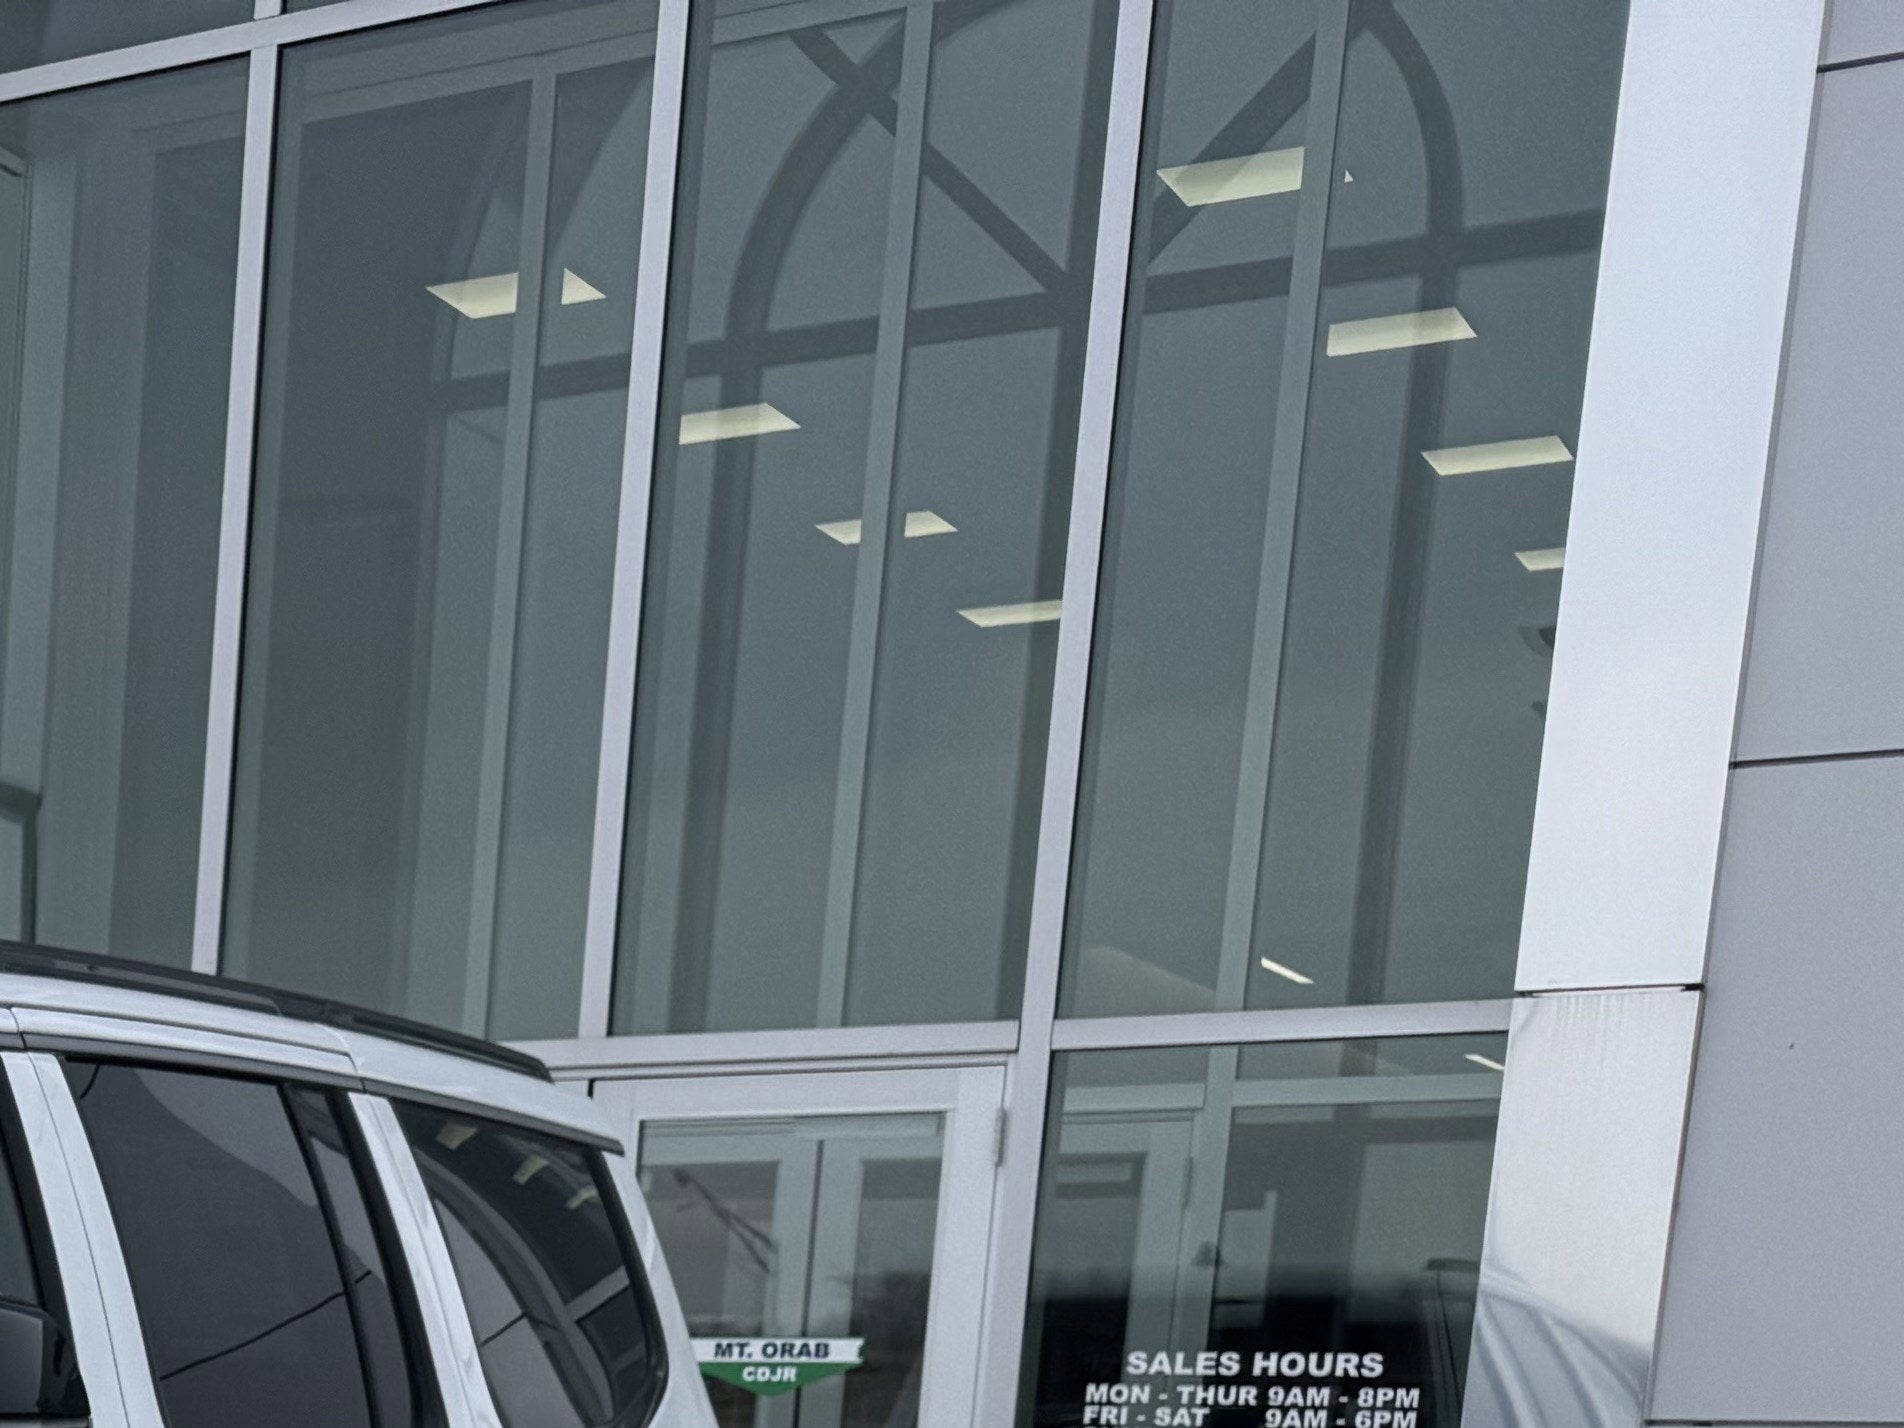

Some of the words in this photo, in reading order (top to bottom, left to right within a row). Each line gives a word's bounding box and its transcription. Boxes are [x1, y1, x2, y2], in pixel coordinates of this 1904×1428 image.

[713, 1342, 753, 1359] MT.
[760, 1342, 831, 1359] ORAB
[1126, 1351, 1241, 1377] SALES
[1252, 1352, 1385, 1378] HOURS
[1085, 1383, 1151, 1405] MON
[1176, 1384, 1259, 1407] THUR
[1267, 1386, 1331, 1408] 9AM
[1356, 1387, 1421, 1409] 8PM
[1082, 1405, 1128, 1426] FRI
[1153, 1406, 1211, 1428] SAT
